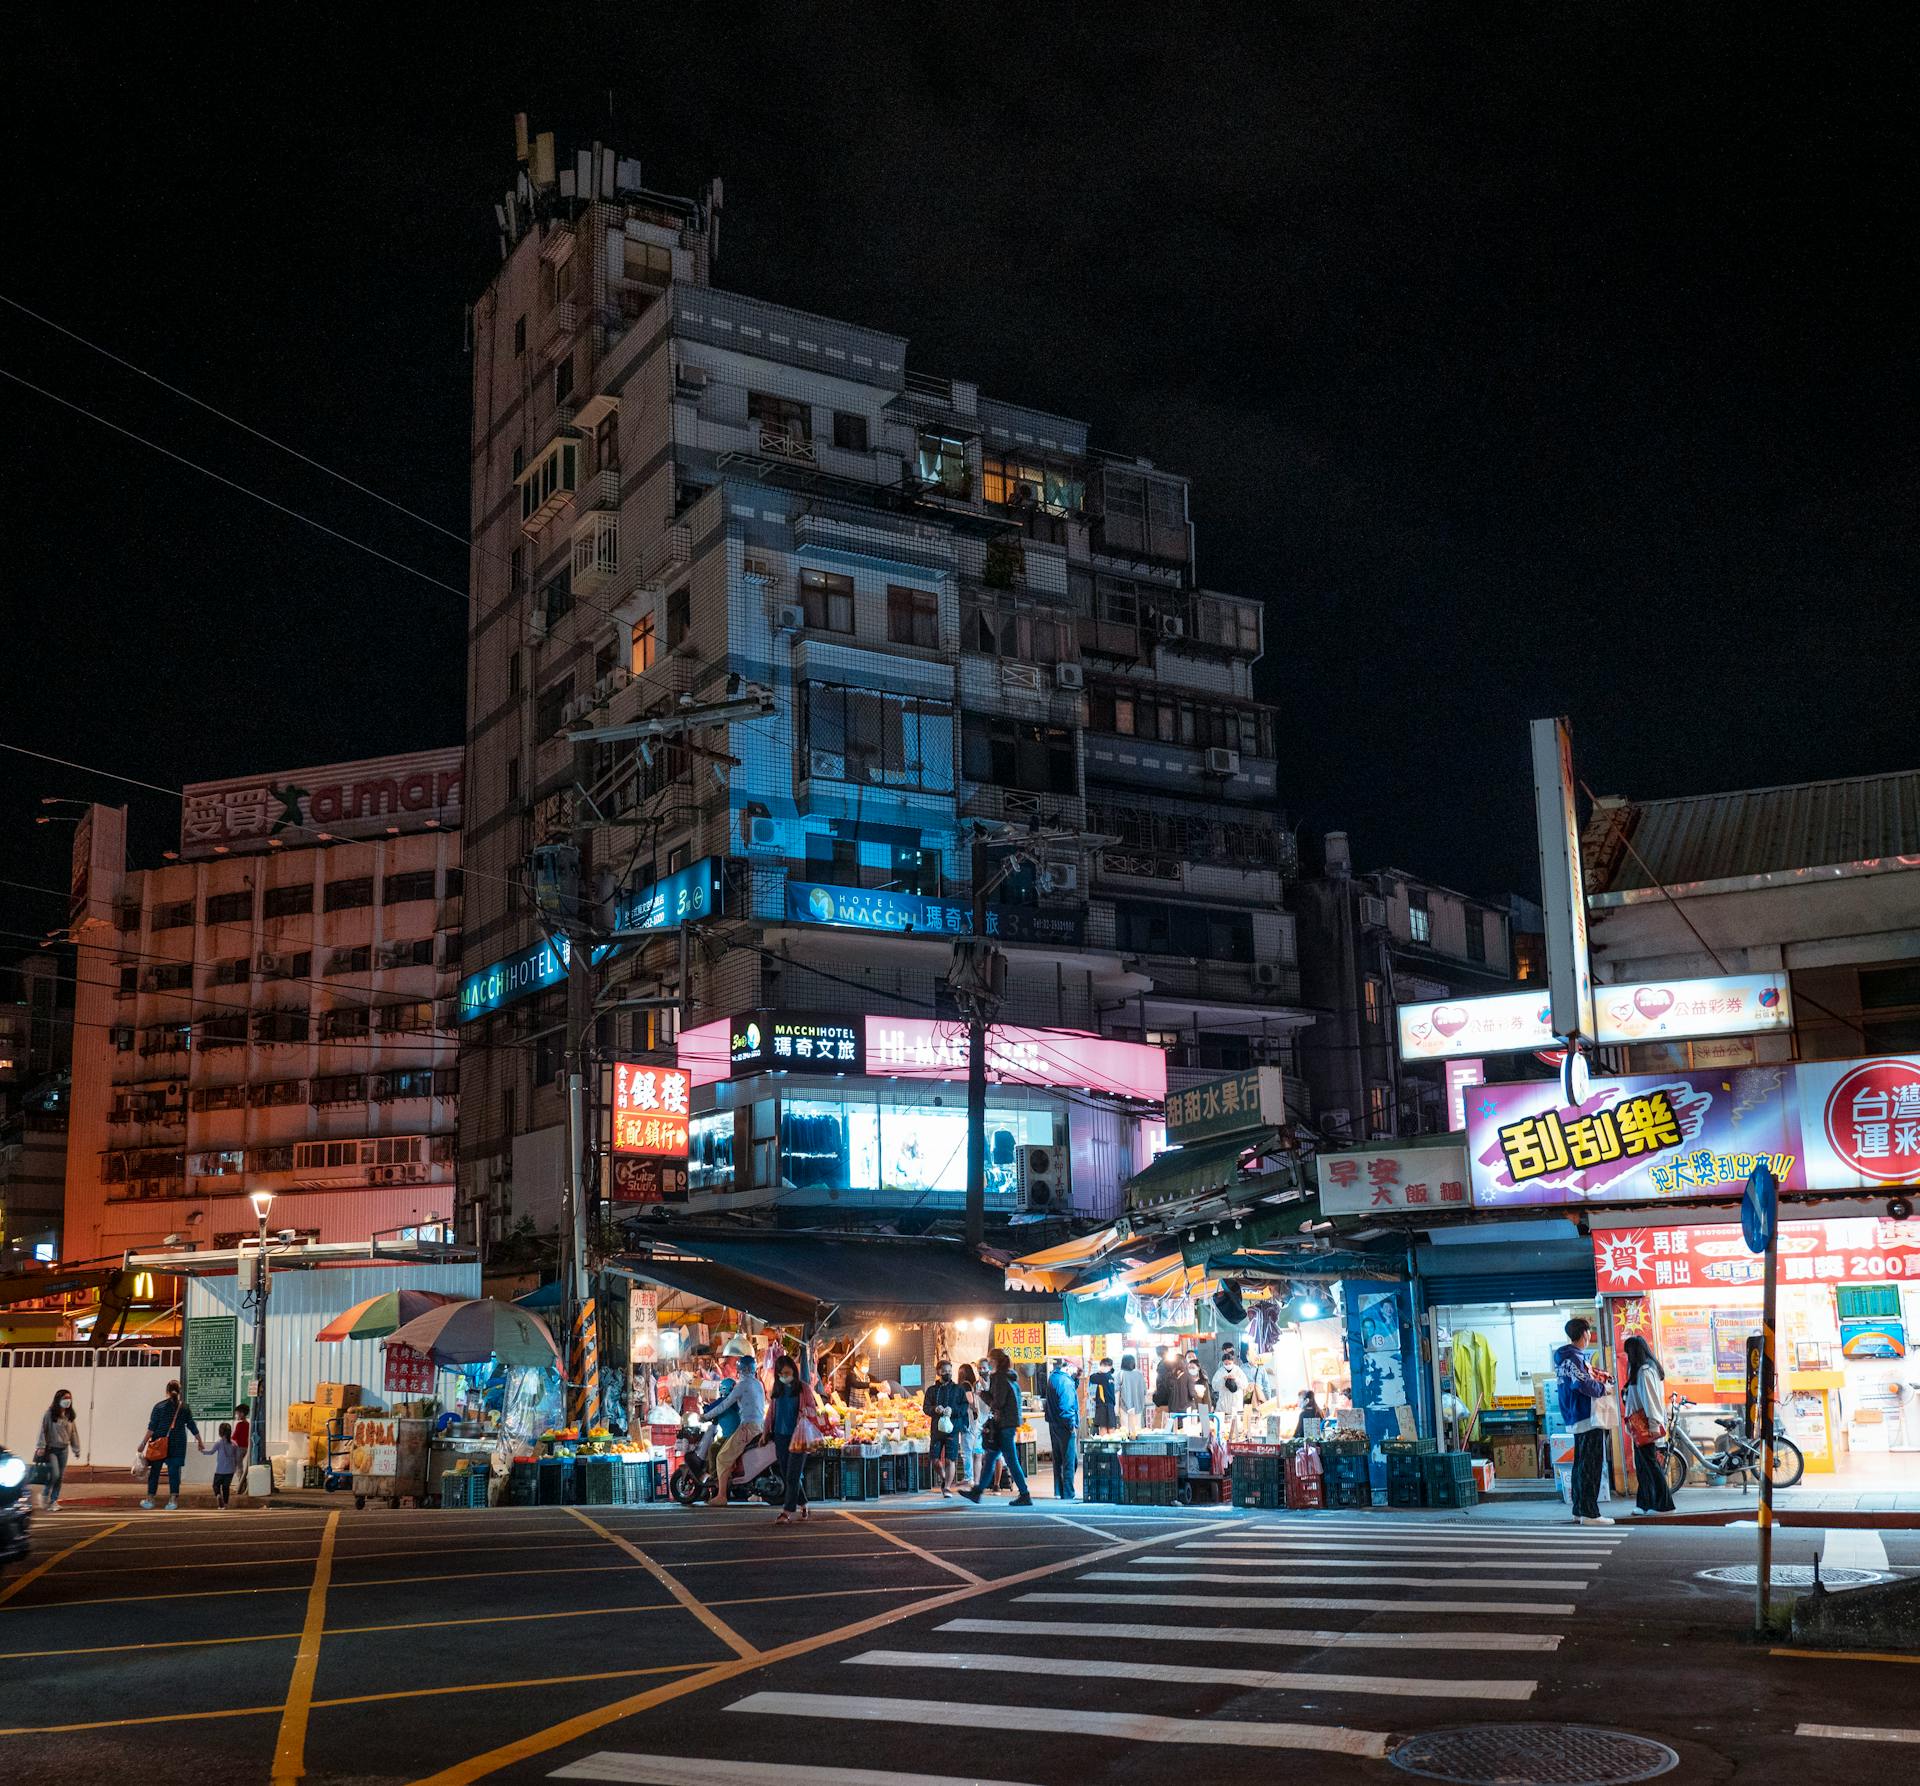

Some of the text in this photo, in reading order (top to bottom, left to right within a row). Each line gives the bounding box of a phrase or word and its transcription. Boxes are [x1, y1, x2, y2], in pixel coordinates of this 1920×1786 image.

[839, 894, 895, 909] HOTEL
[838, 904, 917, 927] MACCHI
[460, 950, 554, 1013] MACCHIHOTEL
[1674, 997, 1743, 1017] 公益彩券
[775, 1025, 856, 1039] MACCHIHOTEL
[774, 1036, 856, 1060] 瑪奇文旅
[630, 1071, 688, 1115] 銀樓
[1167, 1074, 1260, 1127] 甜甜水果行
[626, 1118, 677, 1151] 配鎖行
[1501, 1093, 1681, 1180] 刮刮樂
[1328, 1157, 1400, 1188] 早安
[1652, 1229, 1689, 1256] 再度
[1611, 1246, 1638, 1271] 賀
[1655, 1259, 1692, 1284] 開出
[997, 1327, 1041, 1345] 小甜甜
